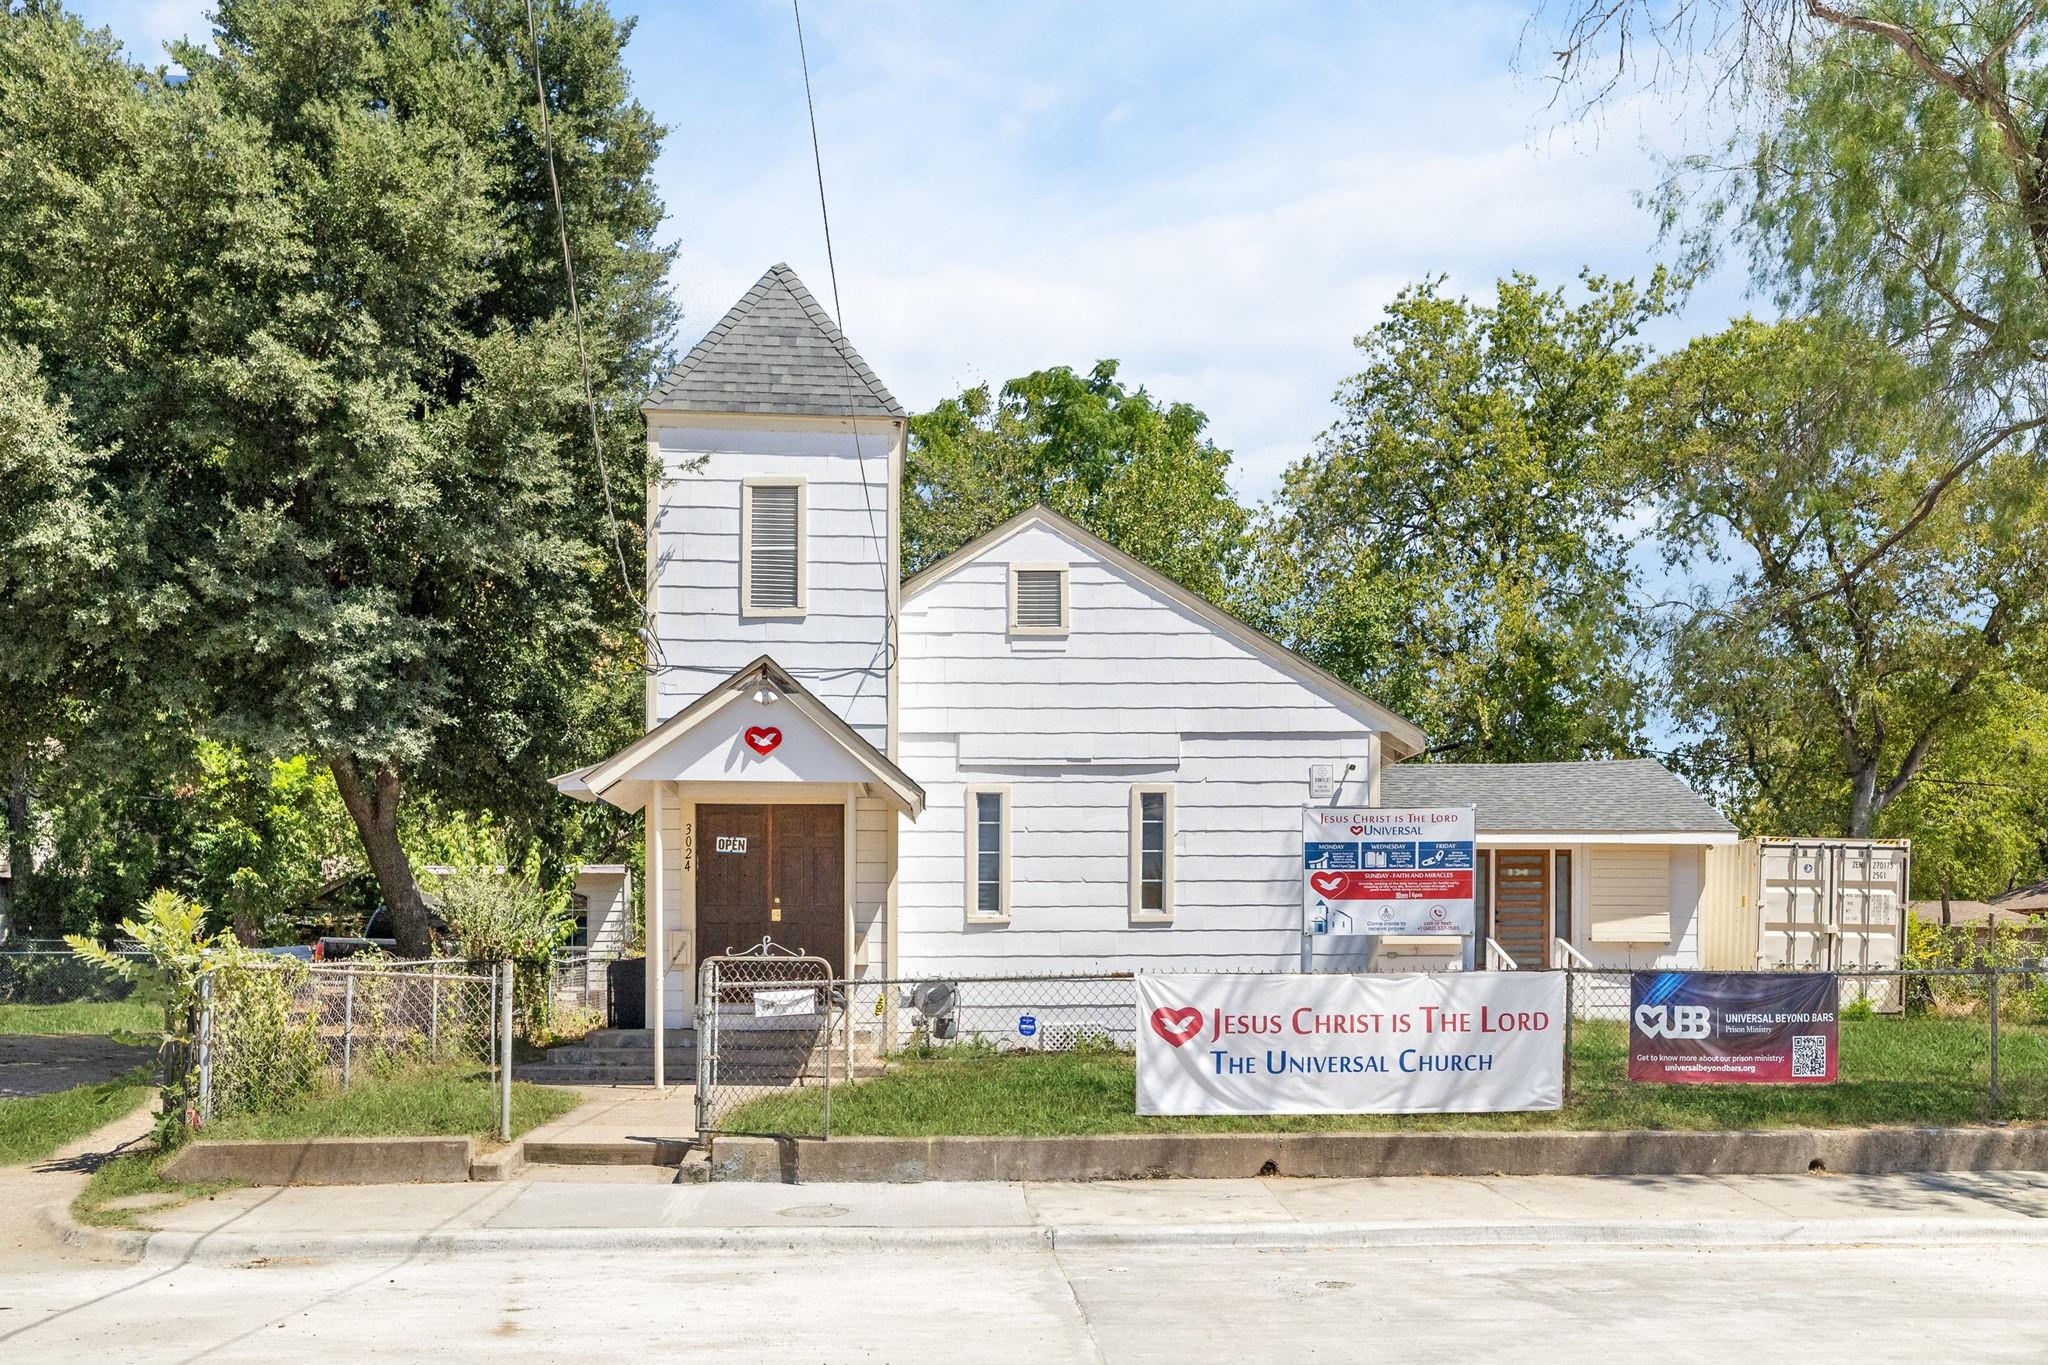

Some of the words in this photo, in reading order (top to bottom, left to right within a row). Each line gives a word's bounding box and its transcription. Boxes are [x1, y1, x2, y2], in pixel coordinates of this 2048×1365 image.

[1320, 813, 1348, 824] JESUS
[1353, 814, 1390, 824] CHRIST
[1394, 815, 1404, 823] IS
[1408, 814, 1426, 823] THE
[1431, 814, 1458, 823] LORD
[1364, 826, 1423, 836] UNIVERSAL
[718, 839, 746, 851] OPEN
[1725, 1014, 1773, 1023] UNIVERSAL
[1775, 1013, 1810, 1023] BEYOND
[1812, 1013, 1834, 1022] BARS
[1210, 1008, 1282, 1043] JESUS
[1292, 1007, 1384, 1036] CHRIST
[1392, 1013, 1411, 1033] IS
[1419, 1006, 1470, 1034] THE
[1480, 1006, 1550, 1033] LORD
[1747, 1026, 1772, 1034] Ministry
[1210, 1050, 1256, 1074] THE
[1266, 1050, 1389, 1076] UNIVERSAL
[1398, 1048, 1492, 1073] CHURCH
[1732, 1055, 1753, 1064] prison
[1755, 1055, 1785, 1064] ministry:
[1665, 1065, 1755, 1073] universalbeyondbars.org
